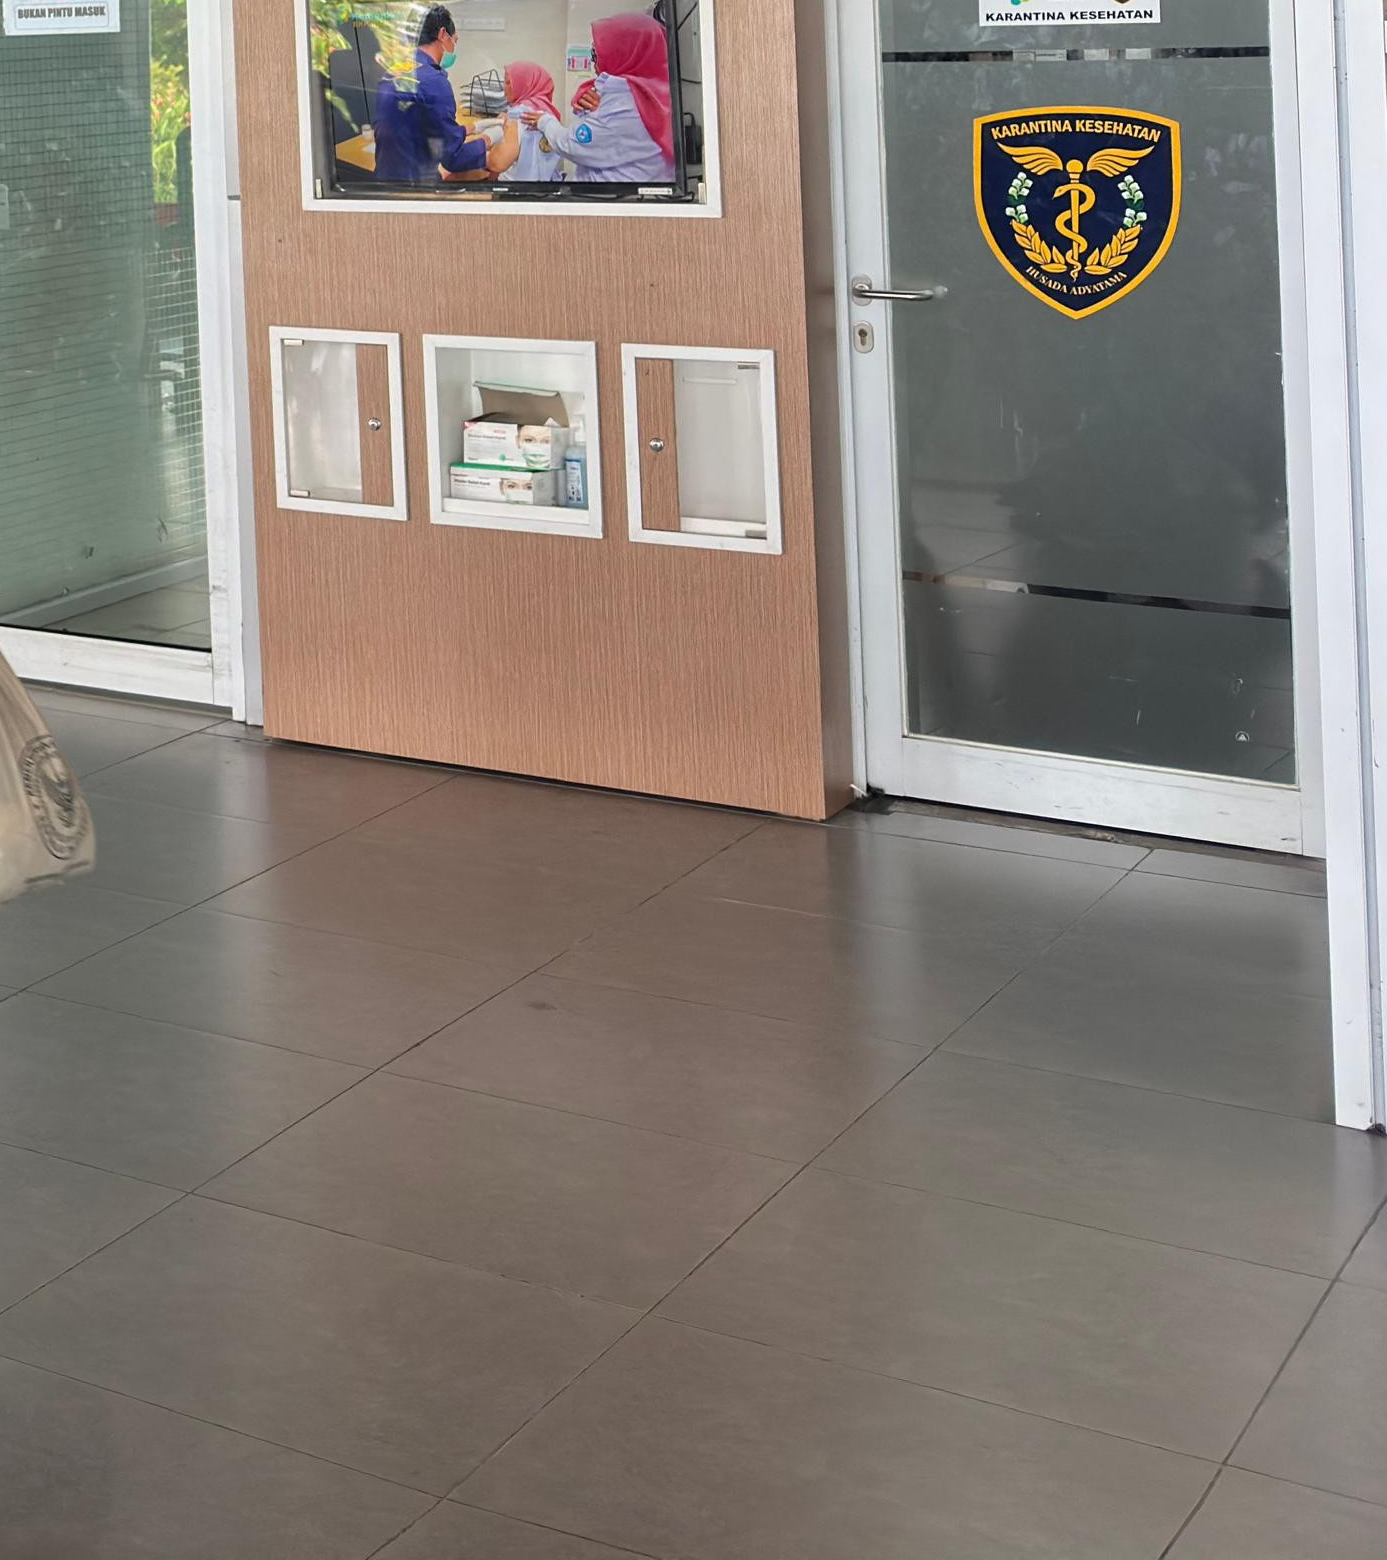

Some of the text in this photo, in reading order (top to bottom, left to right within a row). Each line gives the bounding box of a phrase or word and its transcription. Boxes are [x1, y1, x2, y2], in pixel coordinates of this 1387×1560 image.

[17, 5, 106, 19] BUKAN PINTU MASUK
[985, 8, 1154, 22] KARANTINA KESEHATAN
[990, 118, 1161, 143] KARANTINA KESEHATAN
[1025, 265, 1127, 296] HUSADA ADYATAMA
